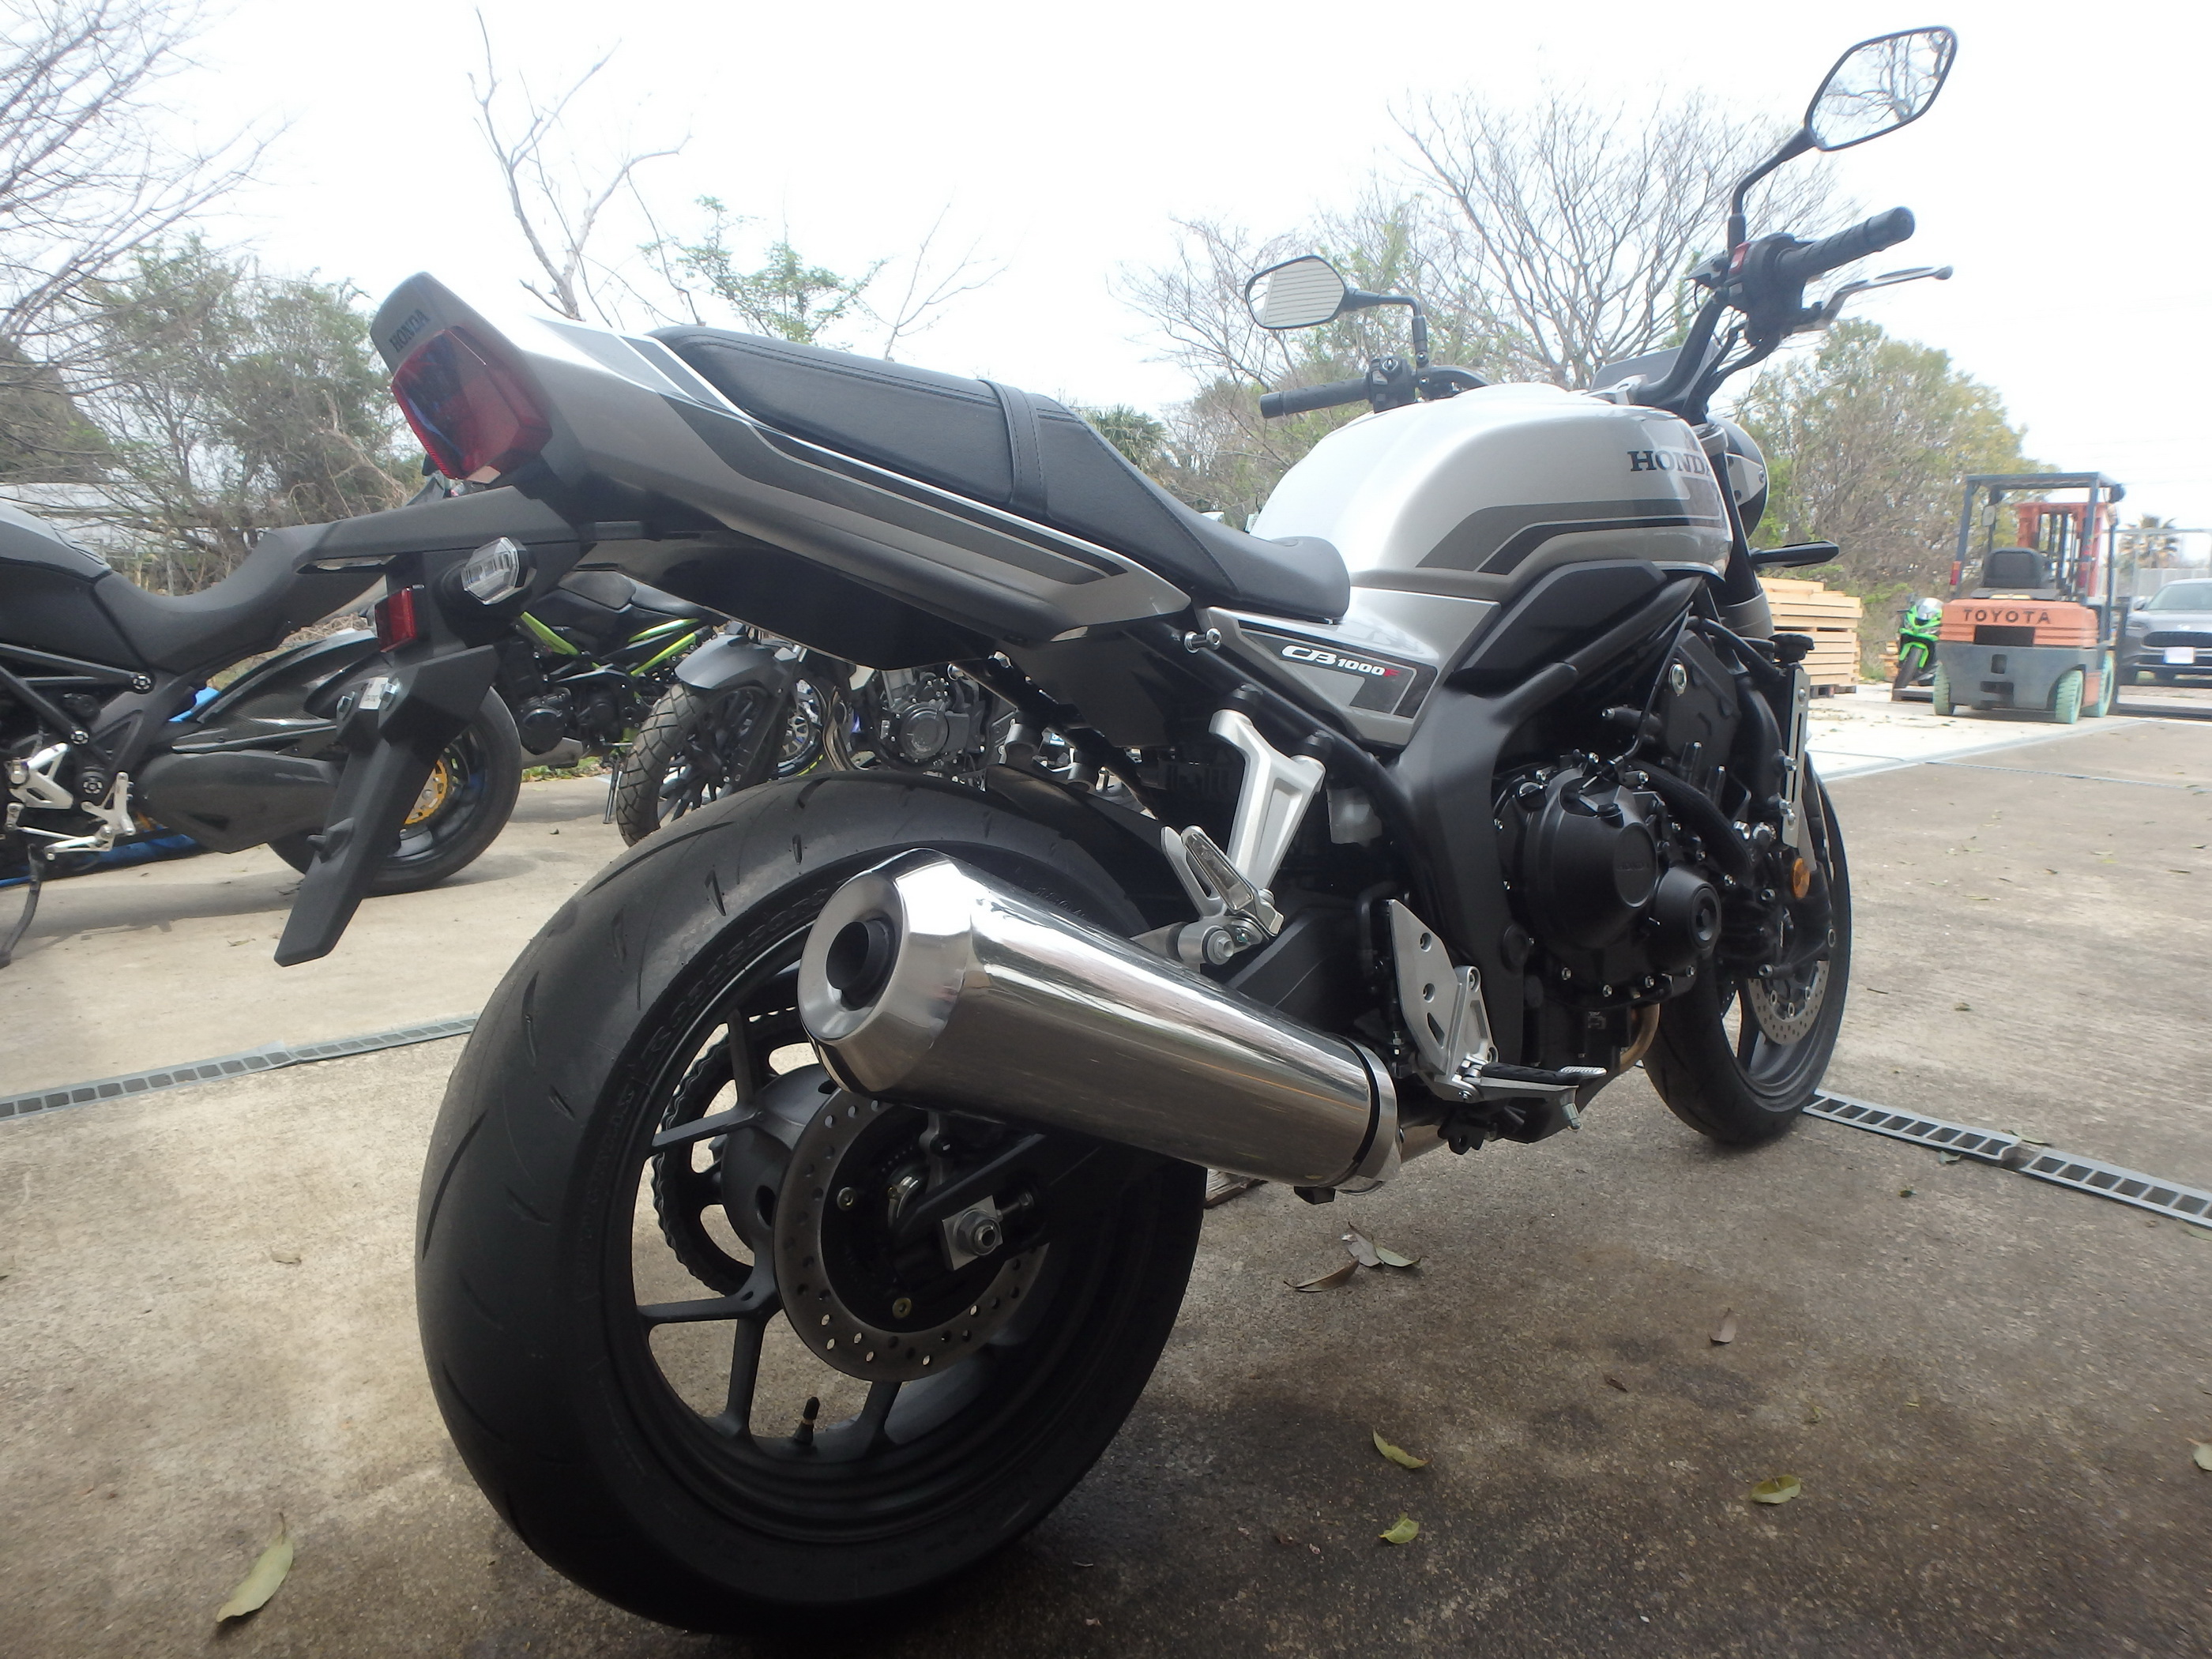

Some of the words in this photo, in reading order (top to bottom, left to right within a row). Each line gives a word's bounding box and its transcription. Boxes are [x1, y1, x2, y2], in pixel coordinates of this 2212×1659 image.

[389, 309, 431, 353] HONDA
[1963, 609, 2050, 624] TOYOTA
[1281, 645, 1401, 677] CB1000F
